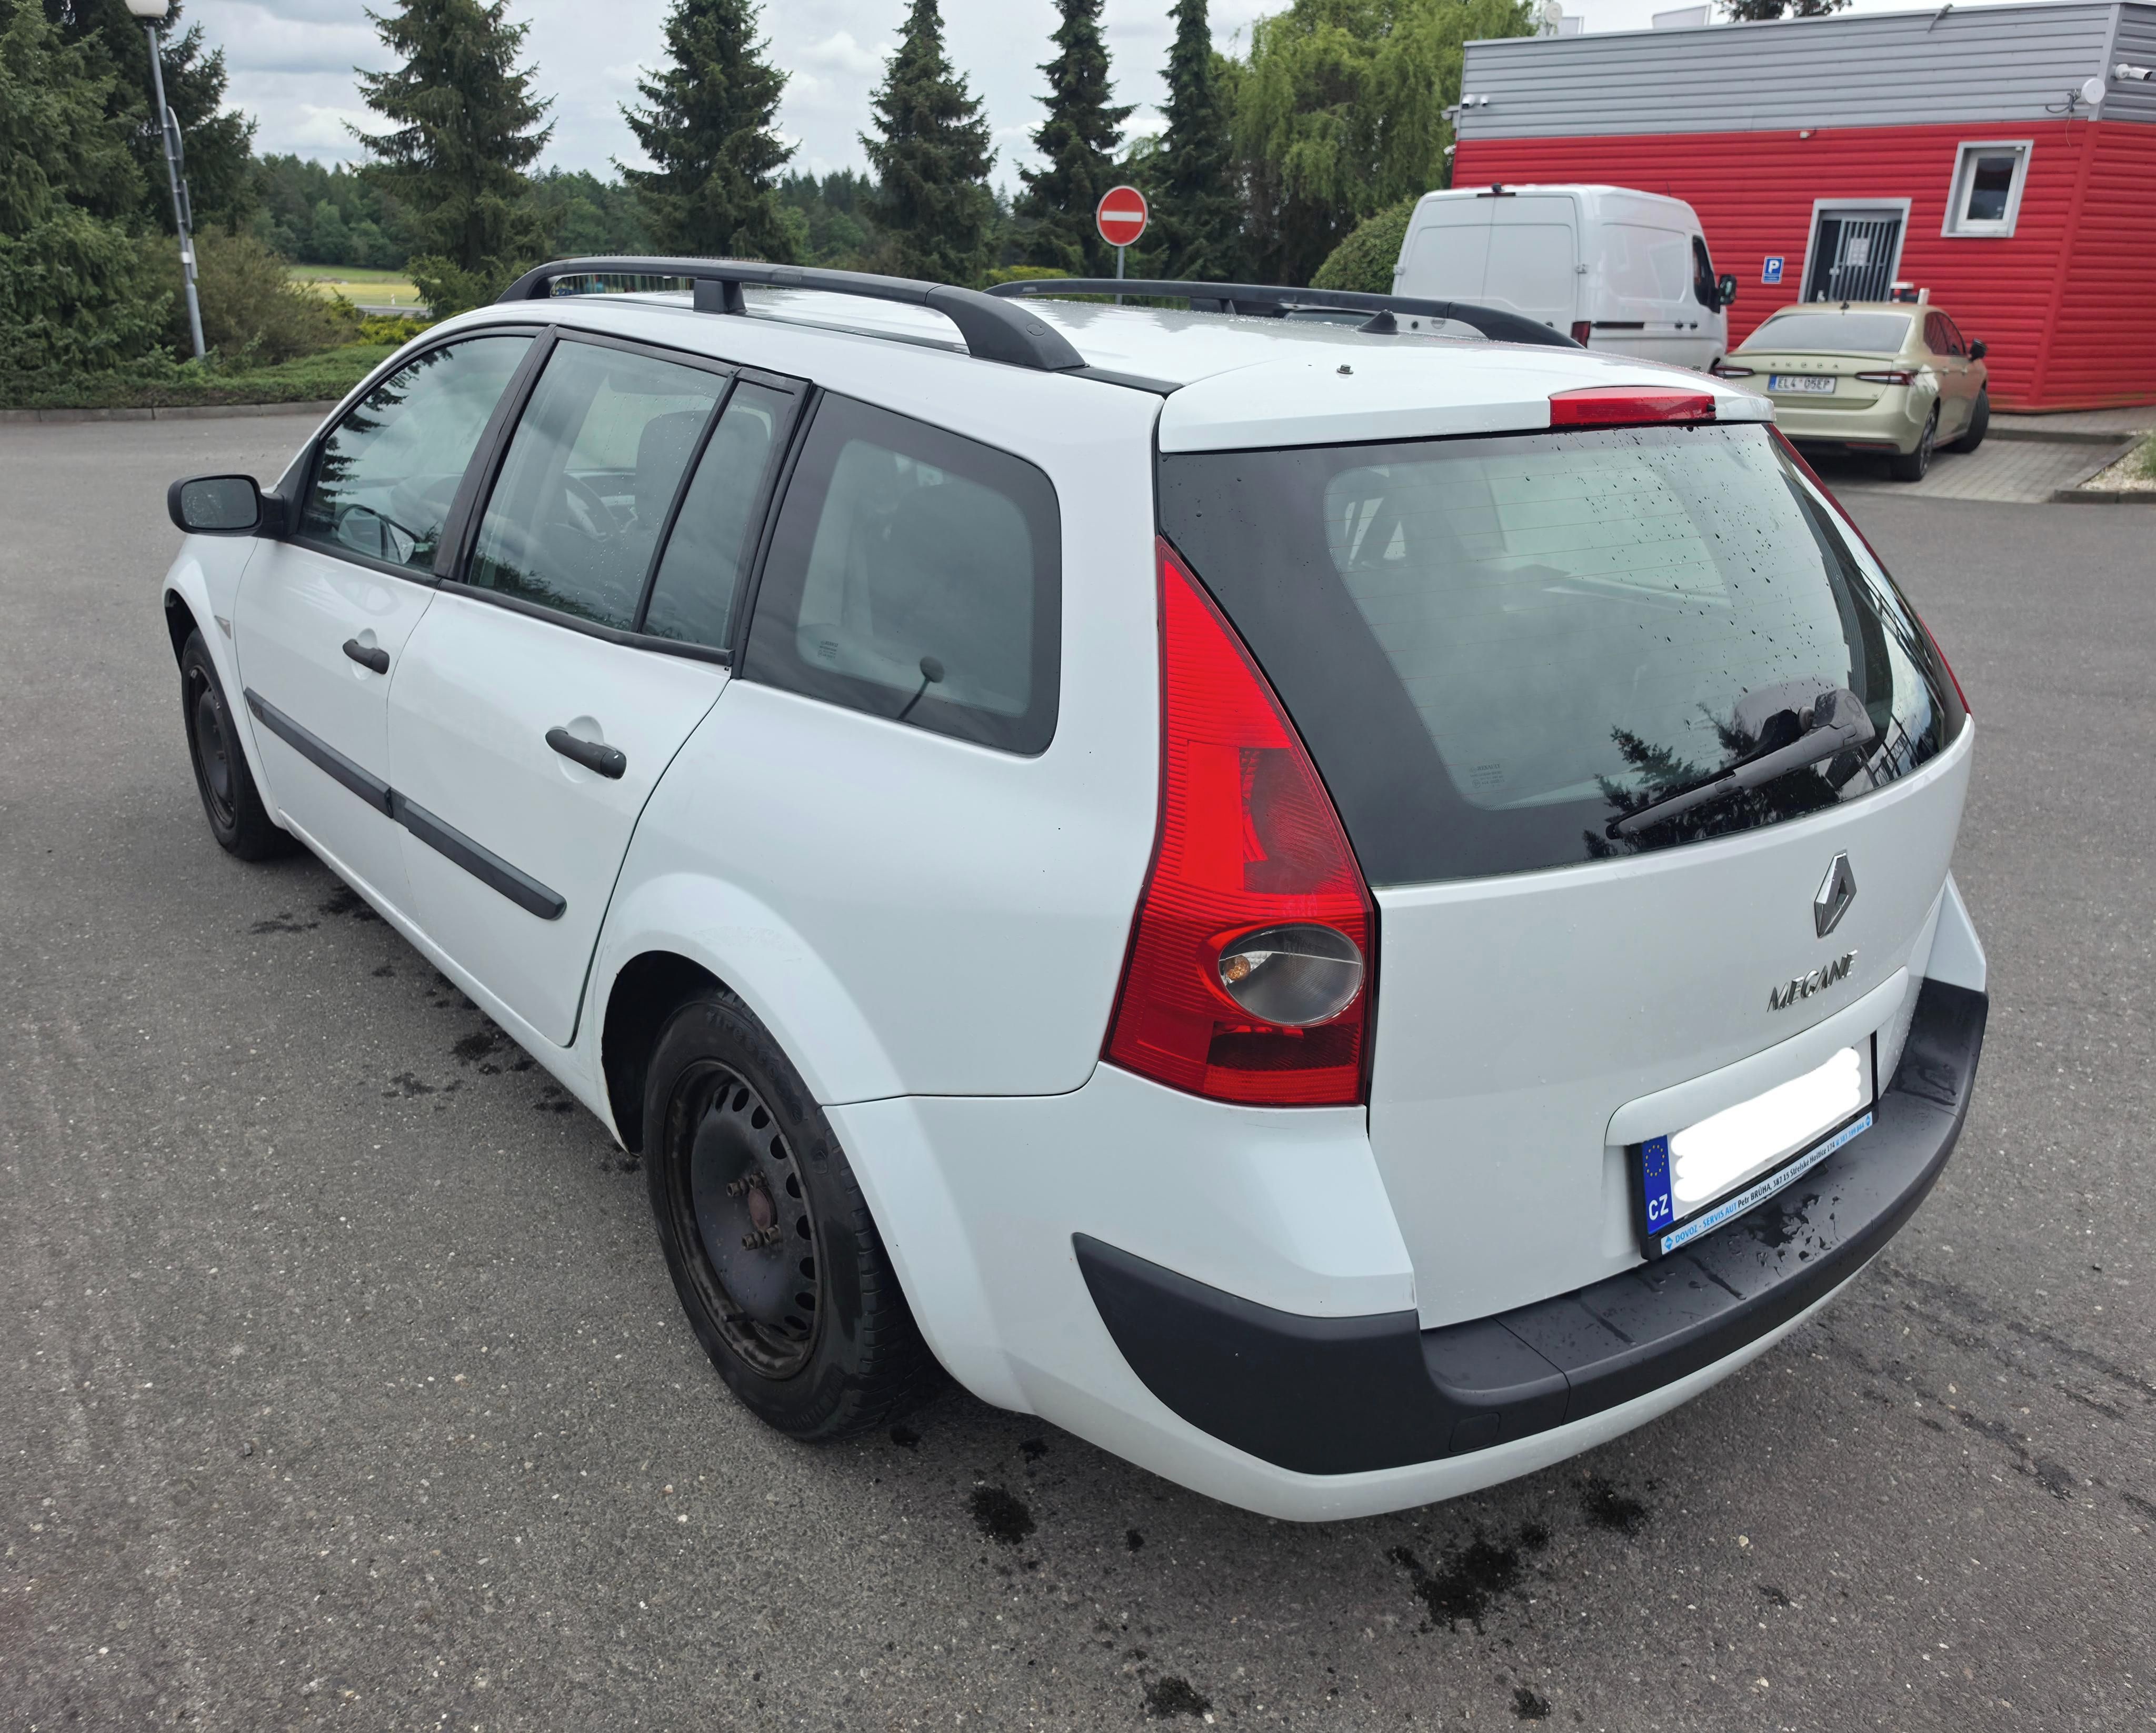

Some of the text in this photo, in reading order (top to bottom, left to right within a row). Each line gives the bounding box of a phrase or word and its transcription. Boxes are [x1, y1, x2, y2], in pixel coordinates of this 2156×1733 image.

[1768, 259, 1780, 274] P
[1766, 949, 1858, 1013] MEGANE
[1649, 1193, 1669, 1221] CZ
[1675, 1225, 1698, 1243] DOVOZ
[1703, 1210, 1724, 1228] SERVIS
[1725, 1202, 1738, 1216] AUT
[1738, 1197, 1750, 1208] Petr
[1773, 1176, 1782, 1187] 387
[1783, 1173, 1790, 1181] 15
